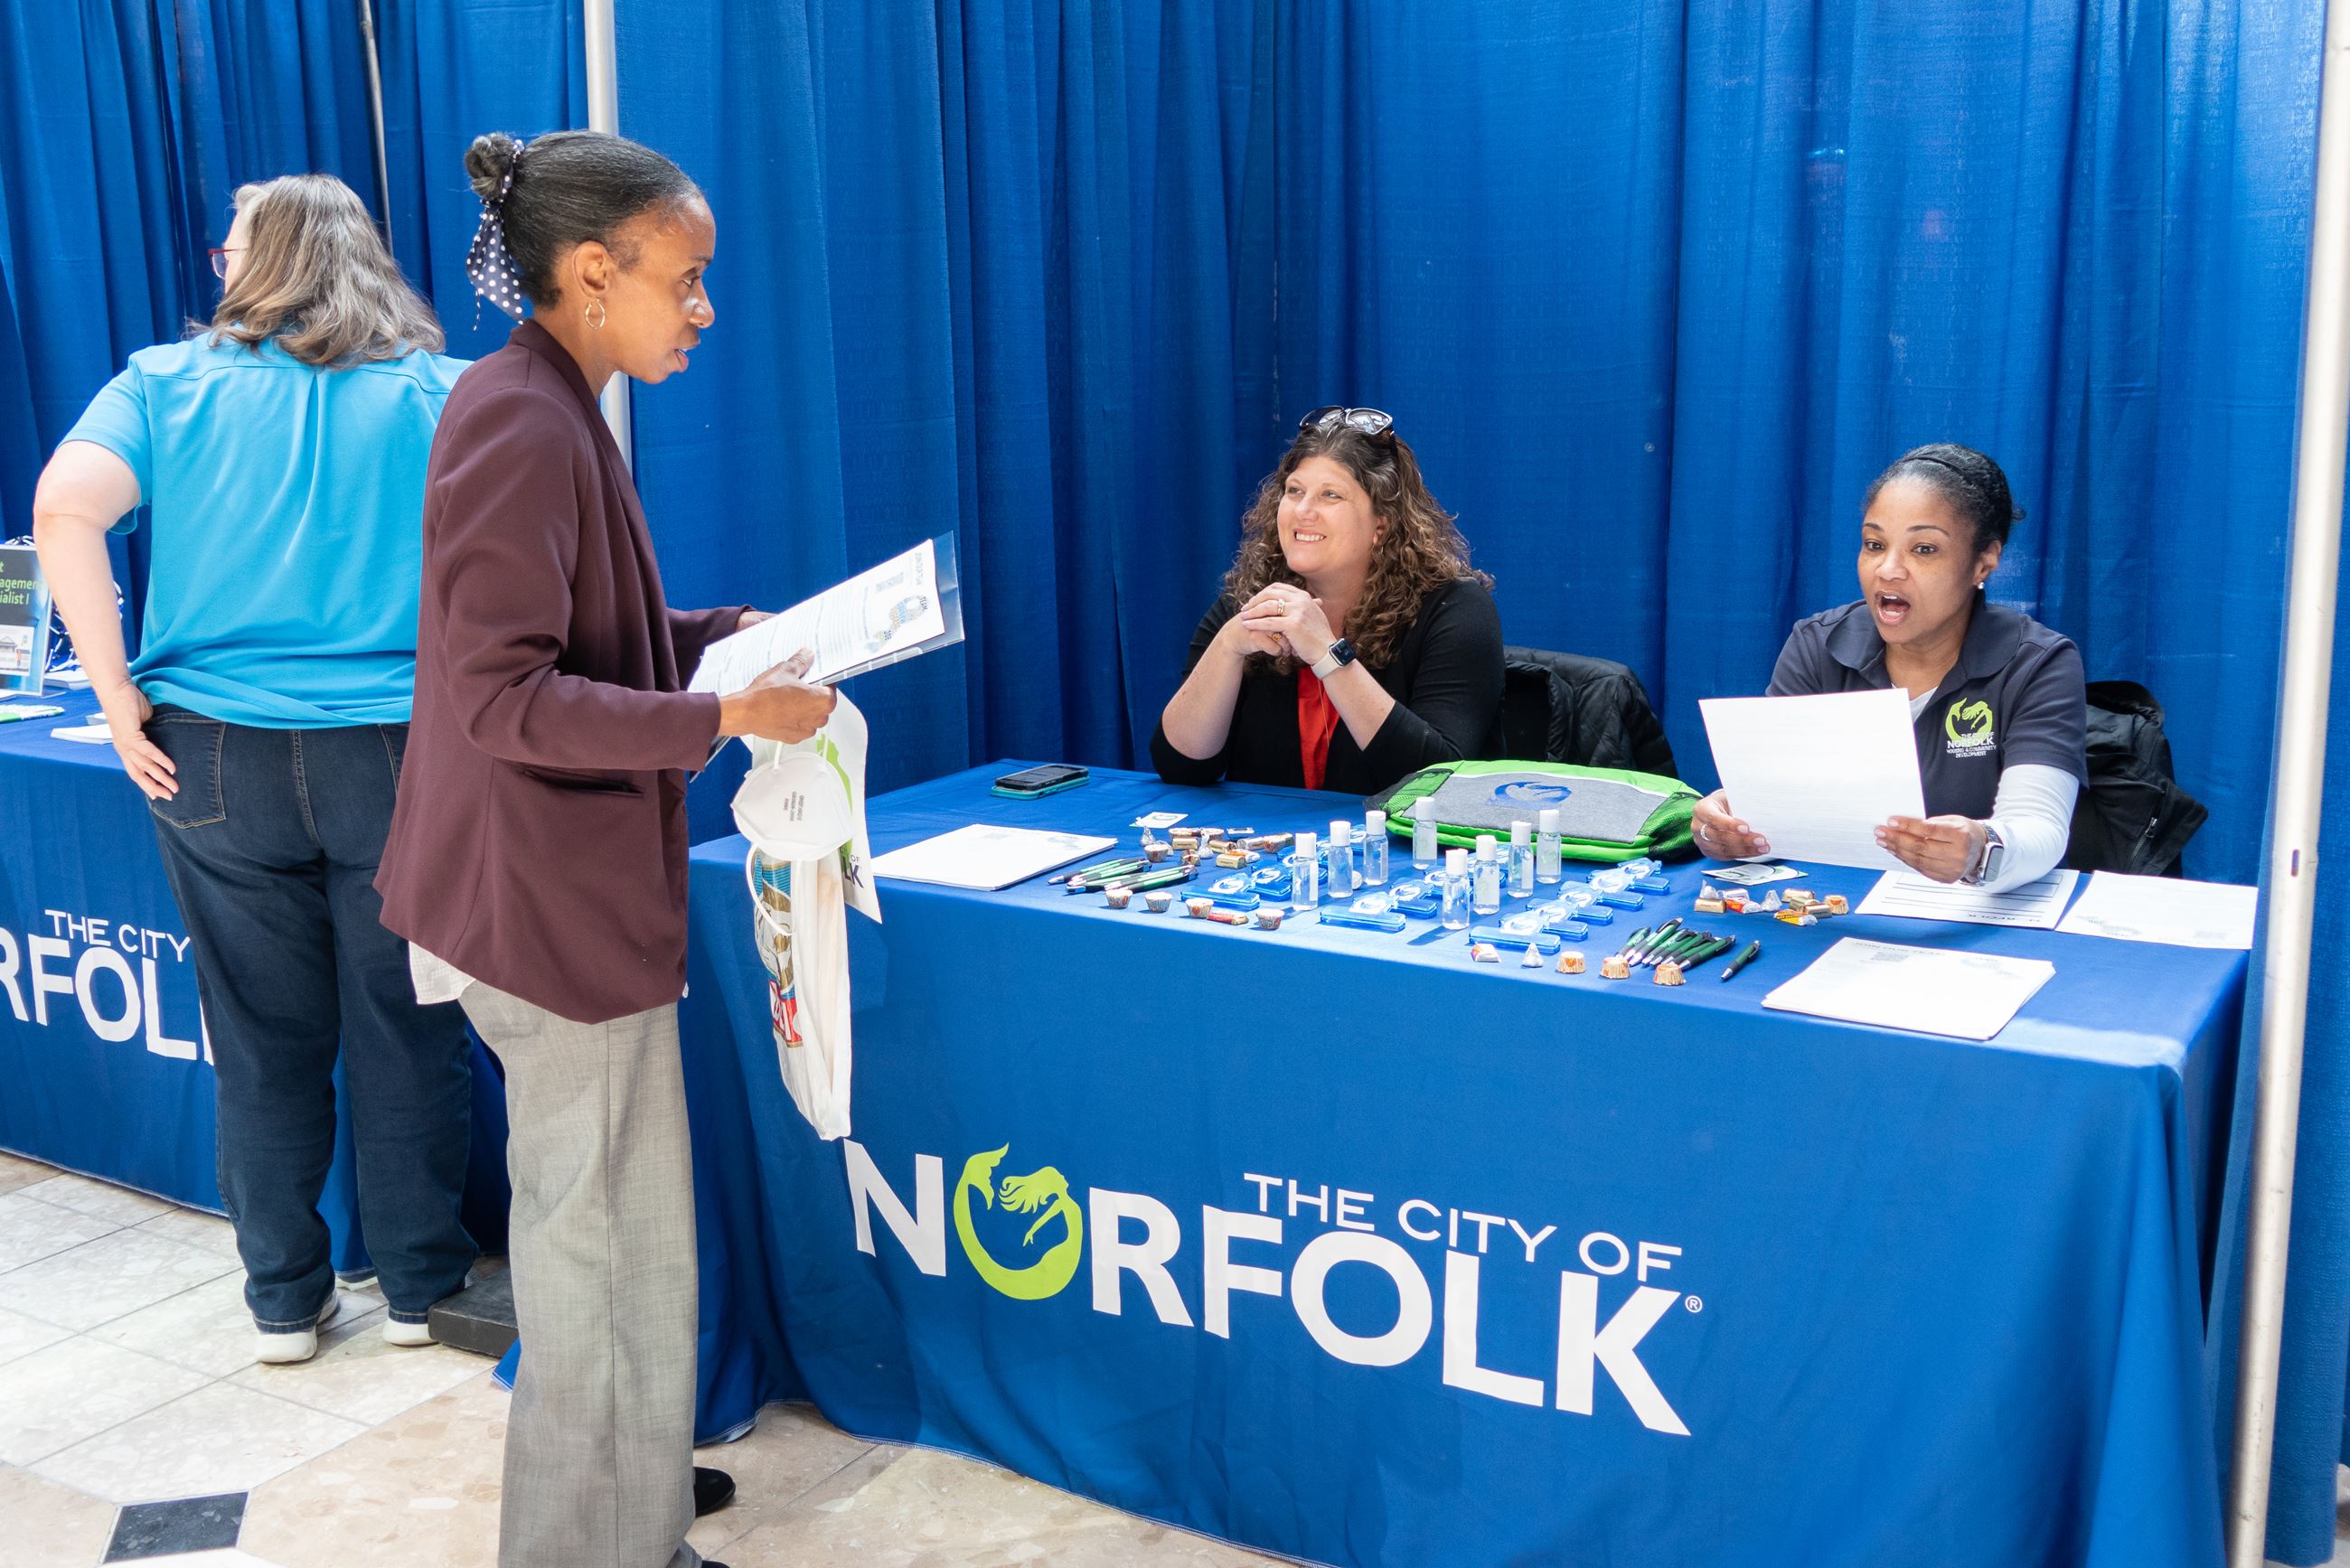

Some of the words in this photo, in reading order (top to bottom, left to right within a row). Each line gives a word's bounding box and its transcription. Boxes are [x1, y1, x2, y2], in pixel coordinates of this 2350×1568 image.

[1947, 737, 1995, 749] NORFOLK
[44, 909, 111, 947] THE
[118, 924, 191, 962] CITY
[0, 927, 214, 1066] RFOL
[1244, 1172, 1375, 1232] THE
[1397, 1199, 1558, 1263] CITY
[1578, 1232, 1682, 1282] OF
